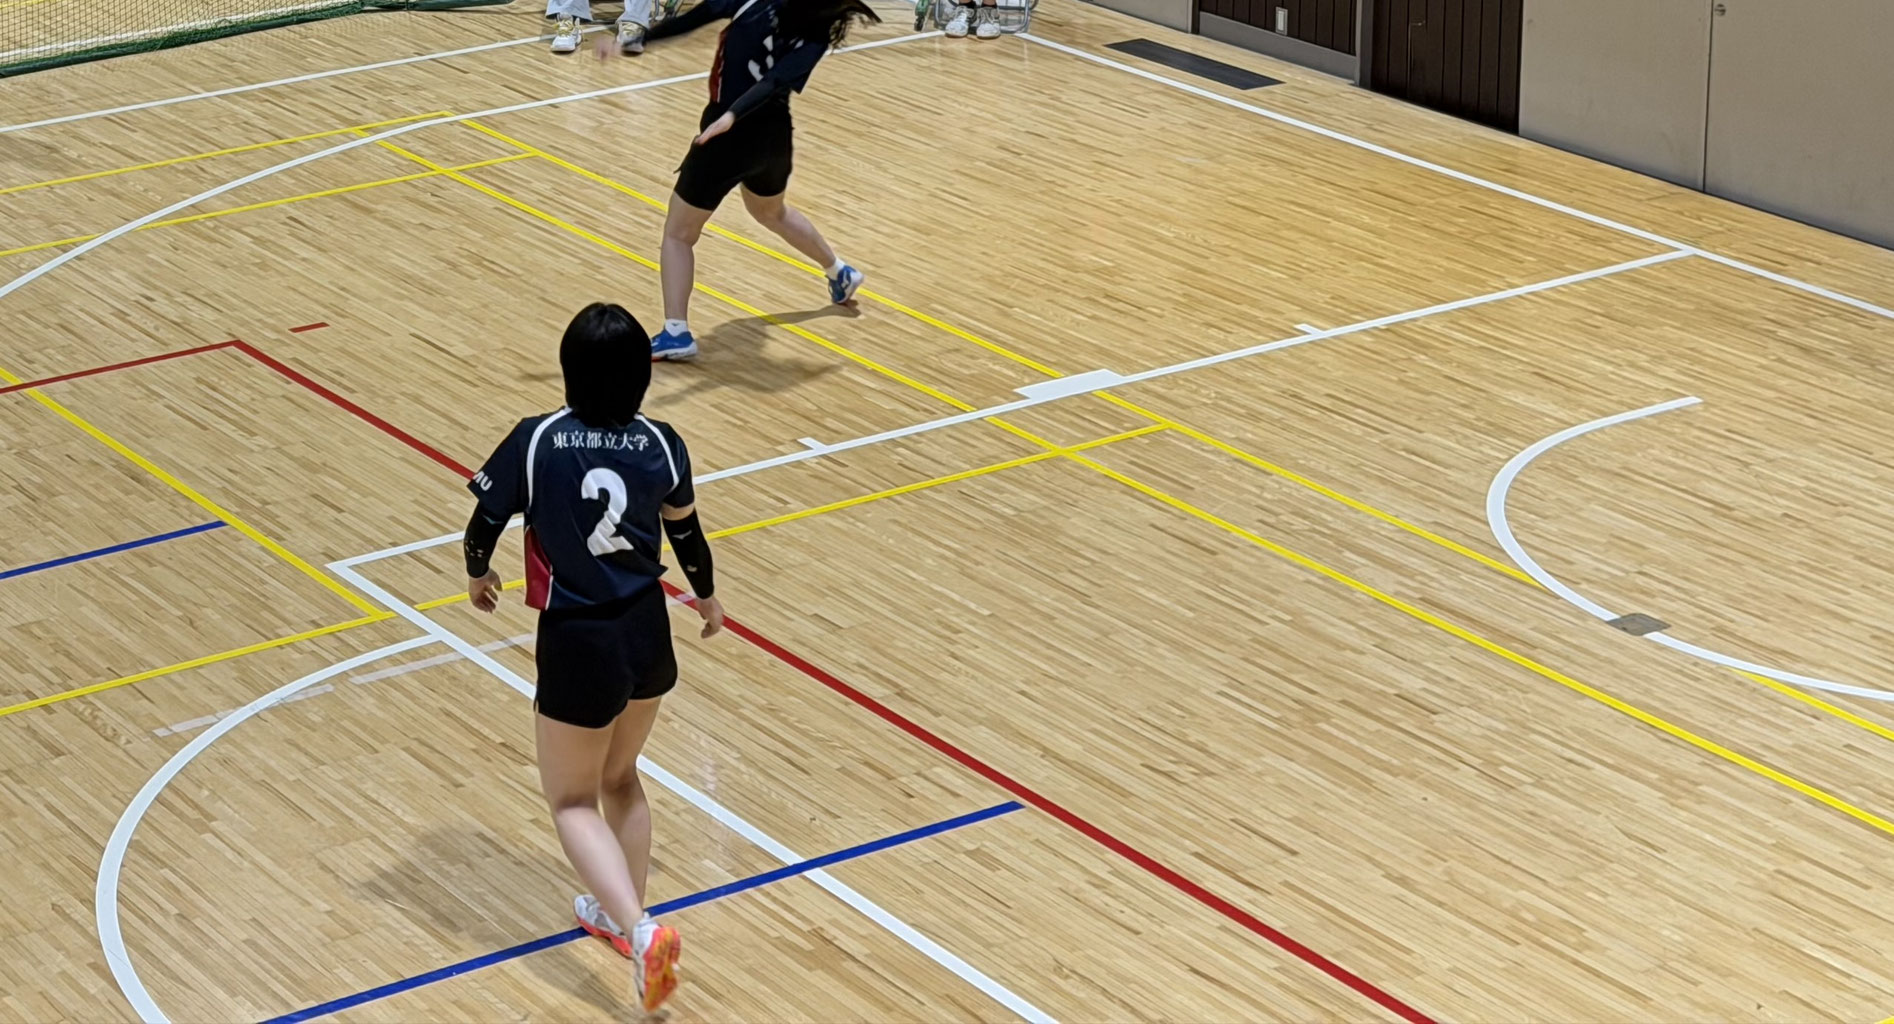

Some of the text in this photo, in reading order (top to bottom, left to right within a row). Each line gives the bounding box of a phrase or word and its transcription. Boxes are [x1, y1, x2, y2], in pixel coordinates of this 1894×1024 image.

[552, 430, 649, 451] 東京都立大学
[581, 467, 634, 557] 2
